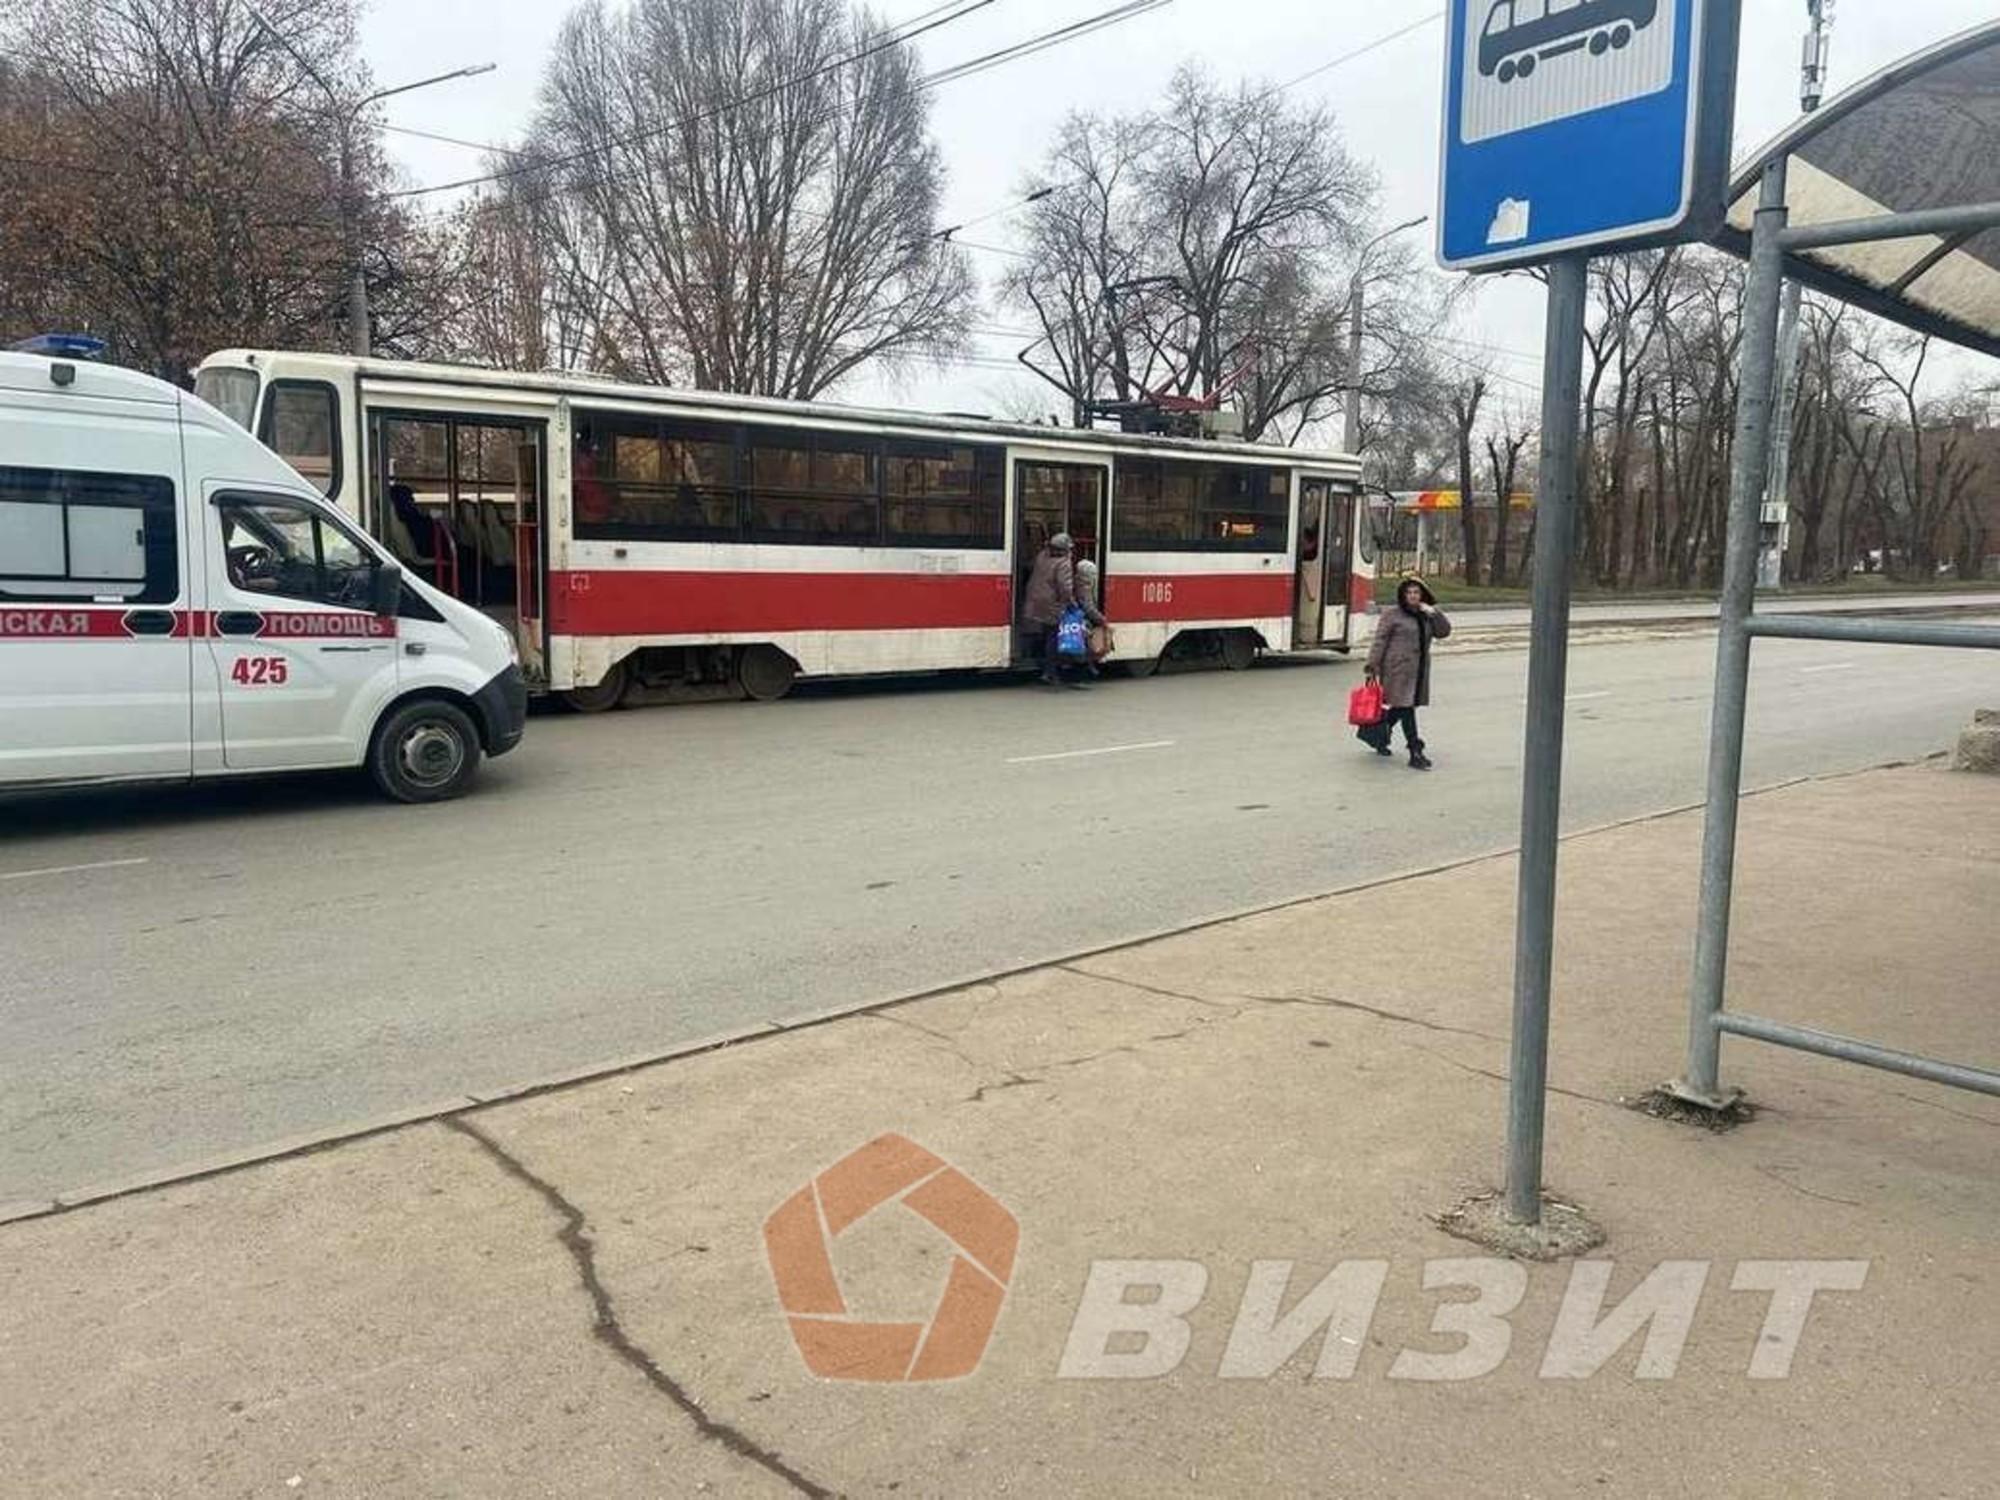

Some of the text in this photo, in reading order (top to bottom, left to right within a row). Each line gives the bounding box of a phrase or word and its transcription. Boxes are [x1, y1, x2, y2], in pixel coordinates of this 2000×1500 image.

[1220, 521, 1229, 538] 7
[1142, 582, 1173, 602] 1086
[270, 614, 384, 637] ПОМОЩЬ
[231, 657, 287, 685] 425
